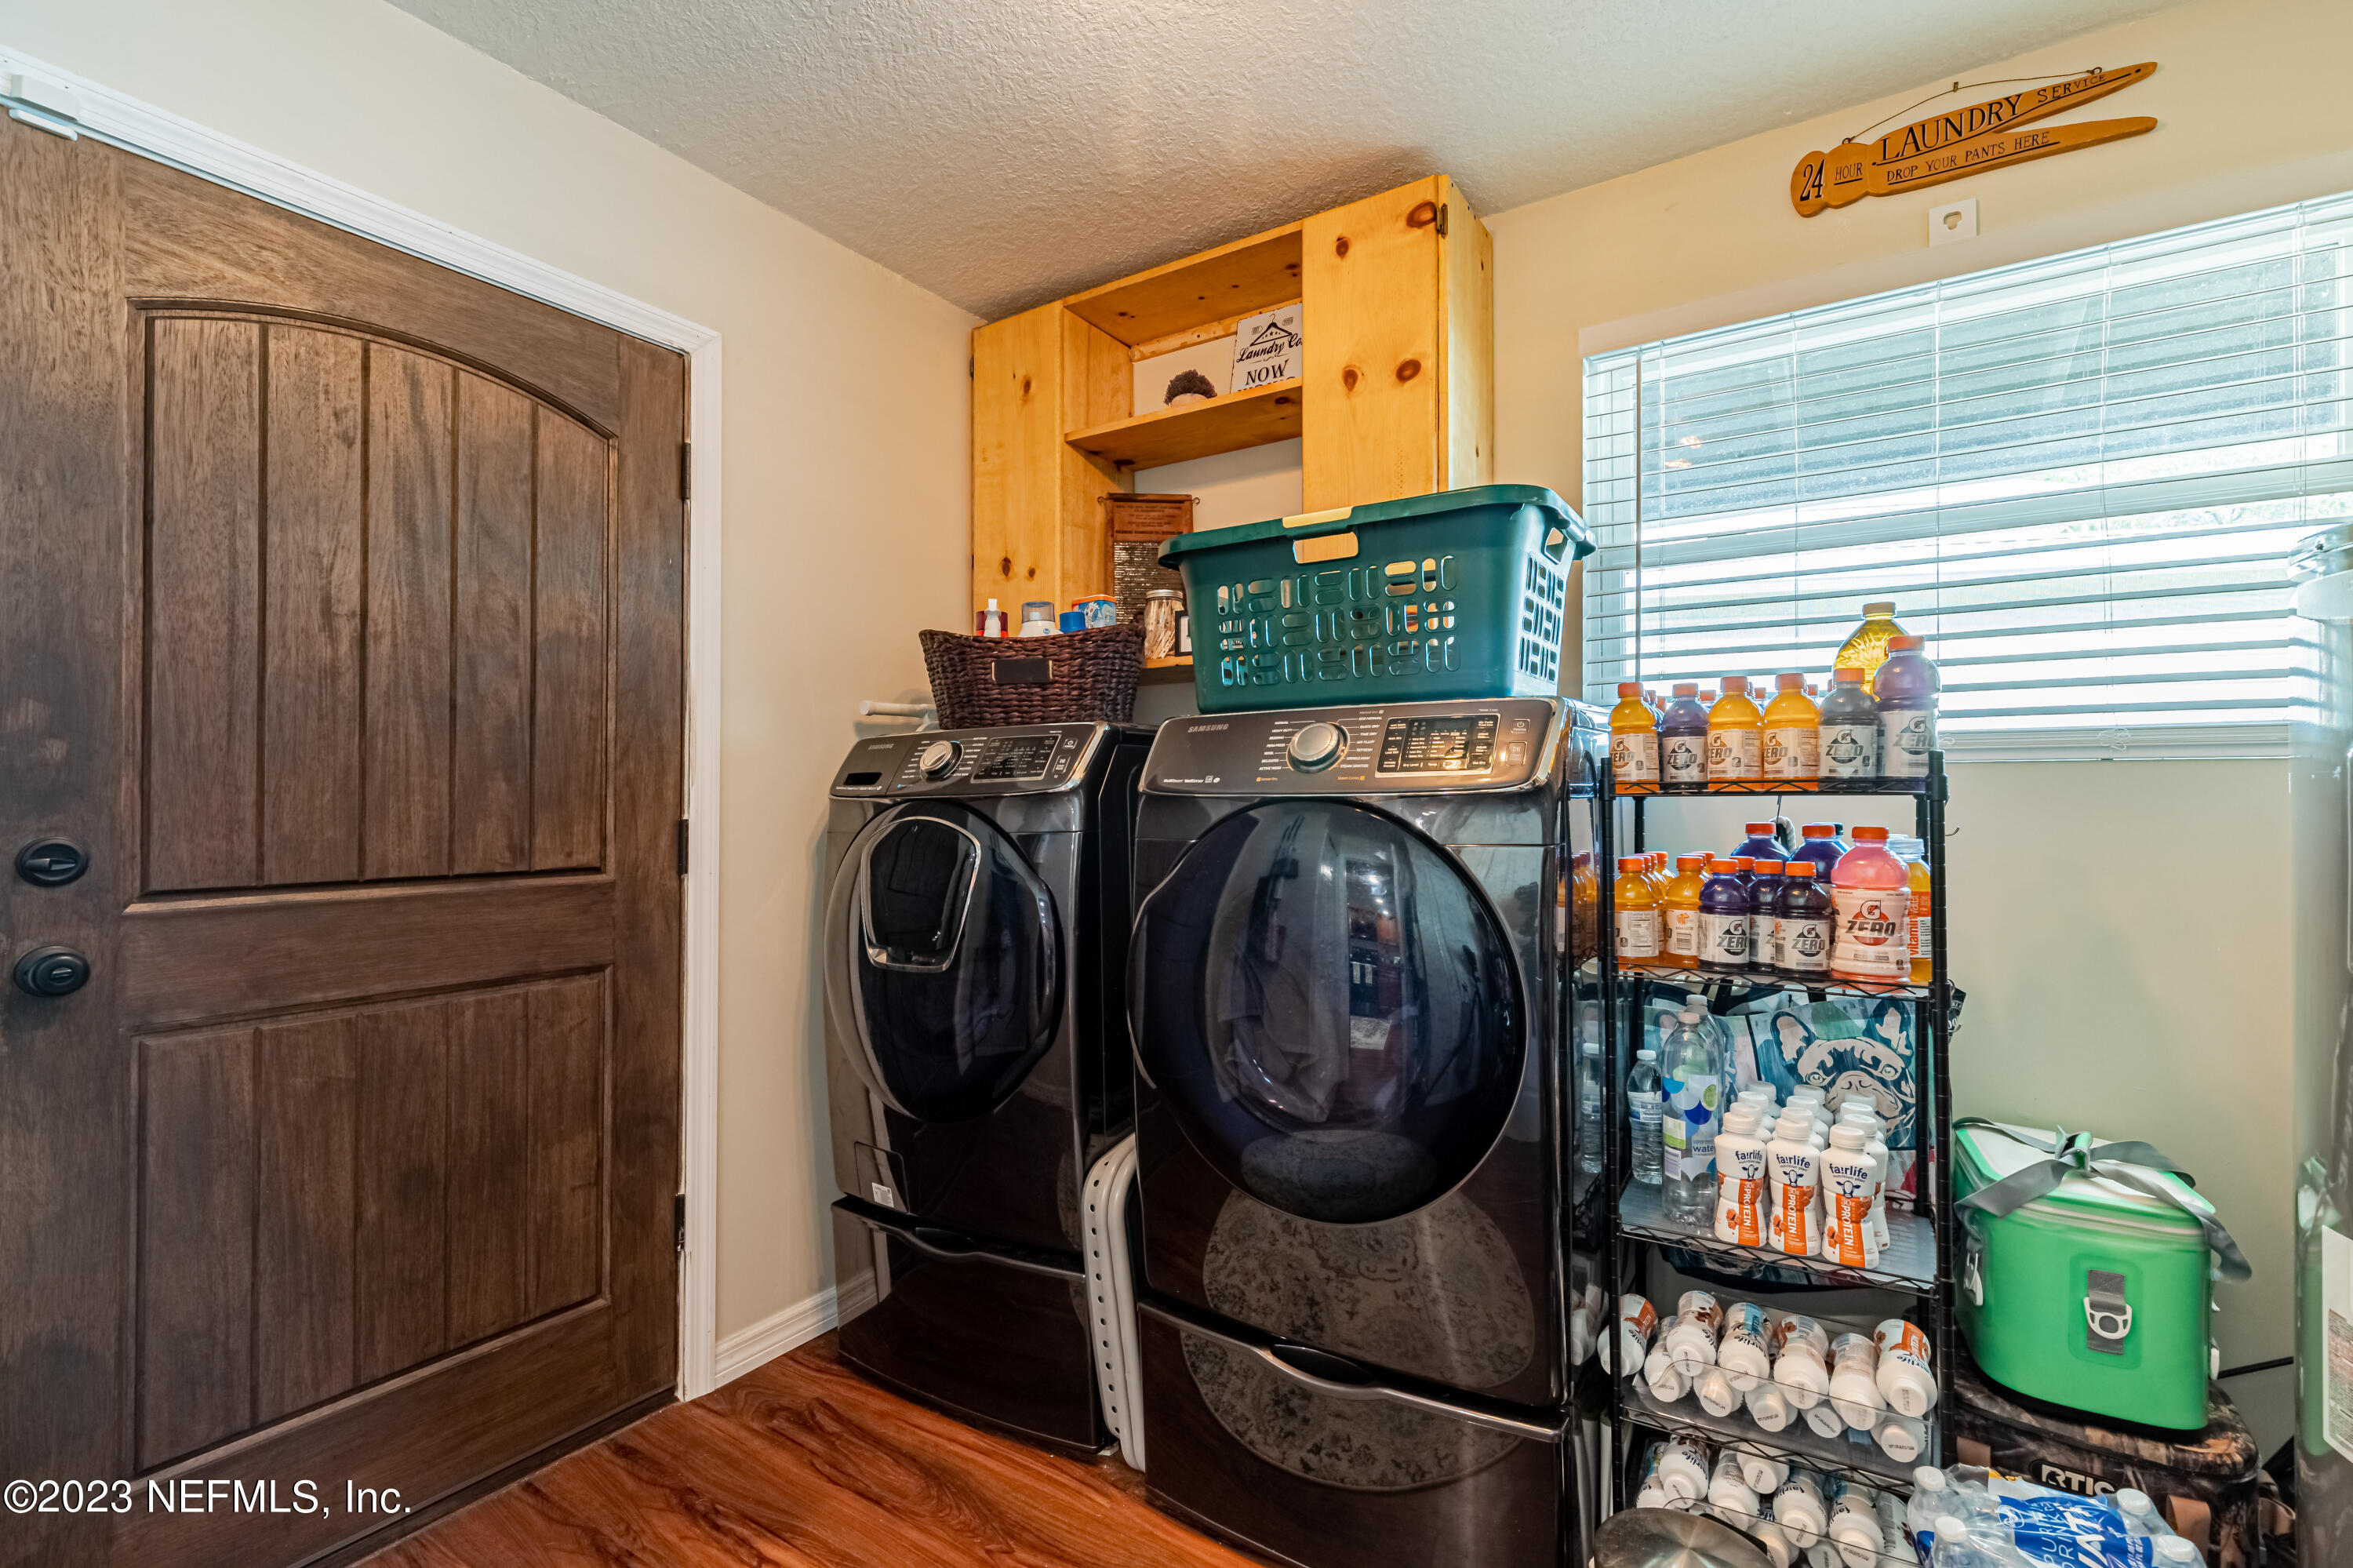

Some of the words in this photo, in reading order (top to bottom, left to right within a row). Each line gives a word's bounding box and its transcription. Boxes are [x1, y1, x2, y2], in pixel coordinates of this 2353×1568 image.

[1880, 93, 2023, 161] LAUNDRY
[2037, 74, 2106, 104] SERVICE
[1886, 165, 1918, 183] DROP
[1926, 155, 1957, 172] YOUR
[1965, 141, 2006, 162] PANTS
[2014, 131, 2049, 151] HERE
[1799, 158, 1825, 202] 24
[1835, 162, 1863, 180] HOUR
[1236, 340, 1285, 362] Laundry
[1246, 358, 1289, 386] NOW
[1187, 723, 1229, 733] SAMSUNG
[1708, 747, 1732, 758] ERO
[1826, 744, 1864, 756] ZERO
[1846, 920, 1897, 937] ZERO
[1791, 938, 1826, 951] ZERO
[1743, 1187, 1751, 1226] PROTEIN
[1787, 1193, 1797, 1234] PROTEIN
[1841, 1204, 1854, 1246] PROTEIN
[1733, 1334, 1766, 1358] irlife
[1897, 1355, 1931, 1377] rlife
[1682, 1450, 1708, 1481] irlife
[1775, 1483, 1805, 1499] fairli
[2042, 1464, 2115, 1496] RTIC
